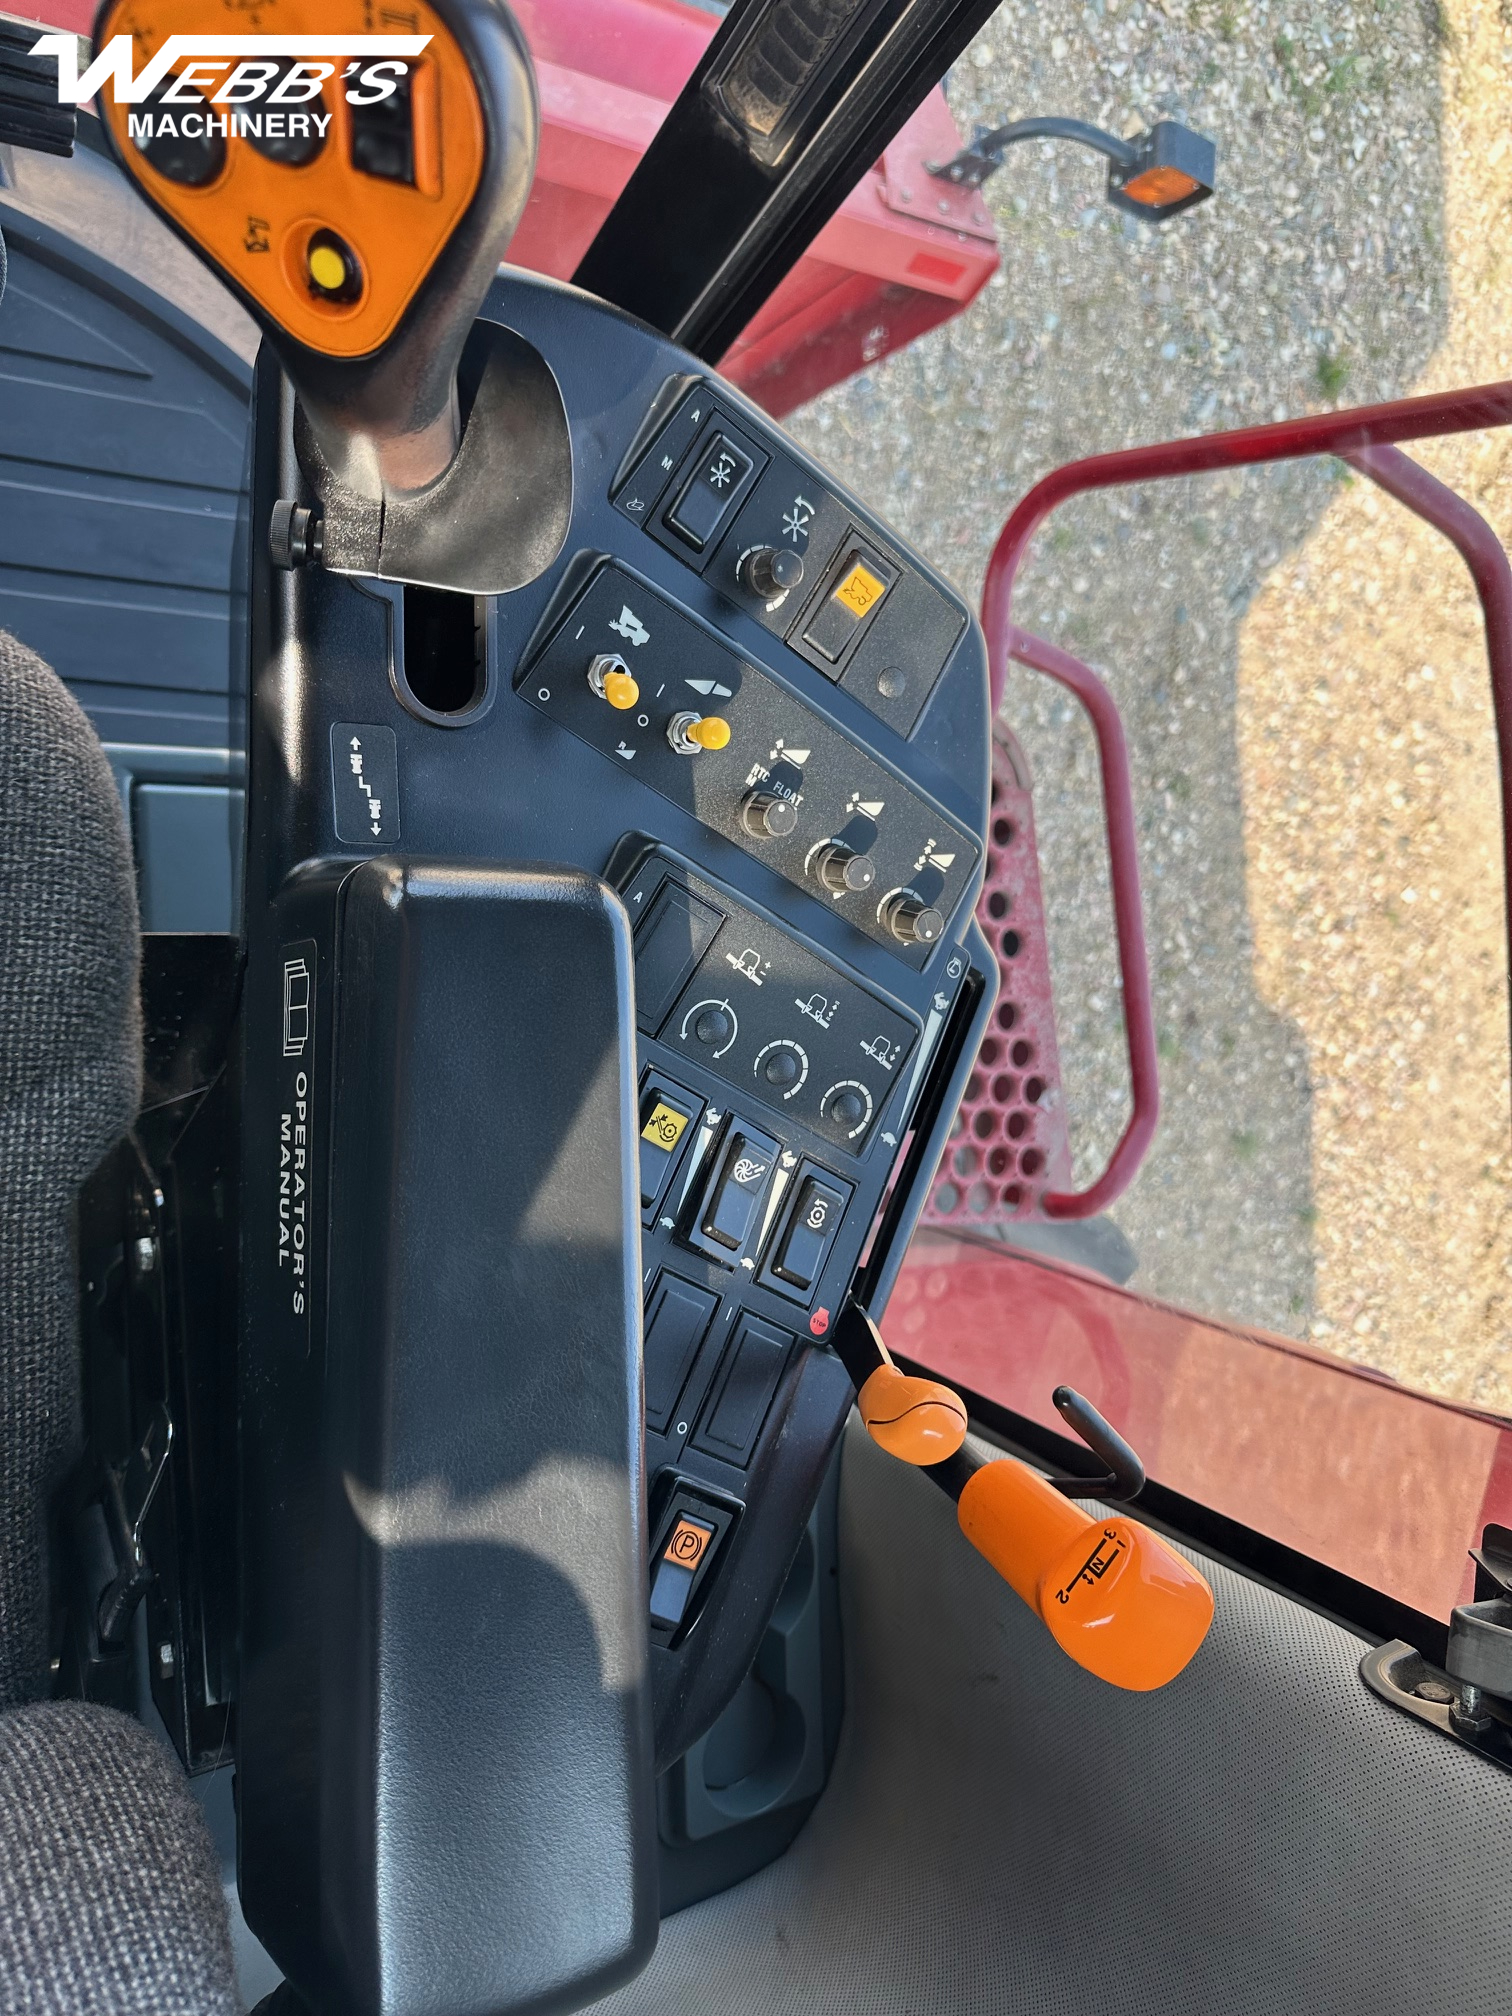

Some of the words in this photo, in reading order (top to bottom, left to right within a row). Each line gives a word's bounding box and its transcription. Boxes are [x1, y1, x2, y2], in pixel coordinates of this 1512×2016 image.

[690, 408, 701, 423] A
[745, 773, 758, 788] M
[750, 762, 771, 783] RTC
[773, 780, 804, 806] FLOAT
[633, 891, 643, 903] A
[279, 1113, 292, 1267] MANUAL
[293, 1071, 308, 1315] OPERATOR'S
[812, 1317, 827, 1329] STOP
[1103, 1527, 1117, 1540] 3
[679, 1534, 695, 1553] P
[1055, 1589, 1070, 1604] 2
